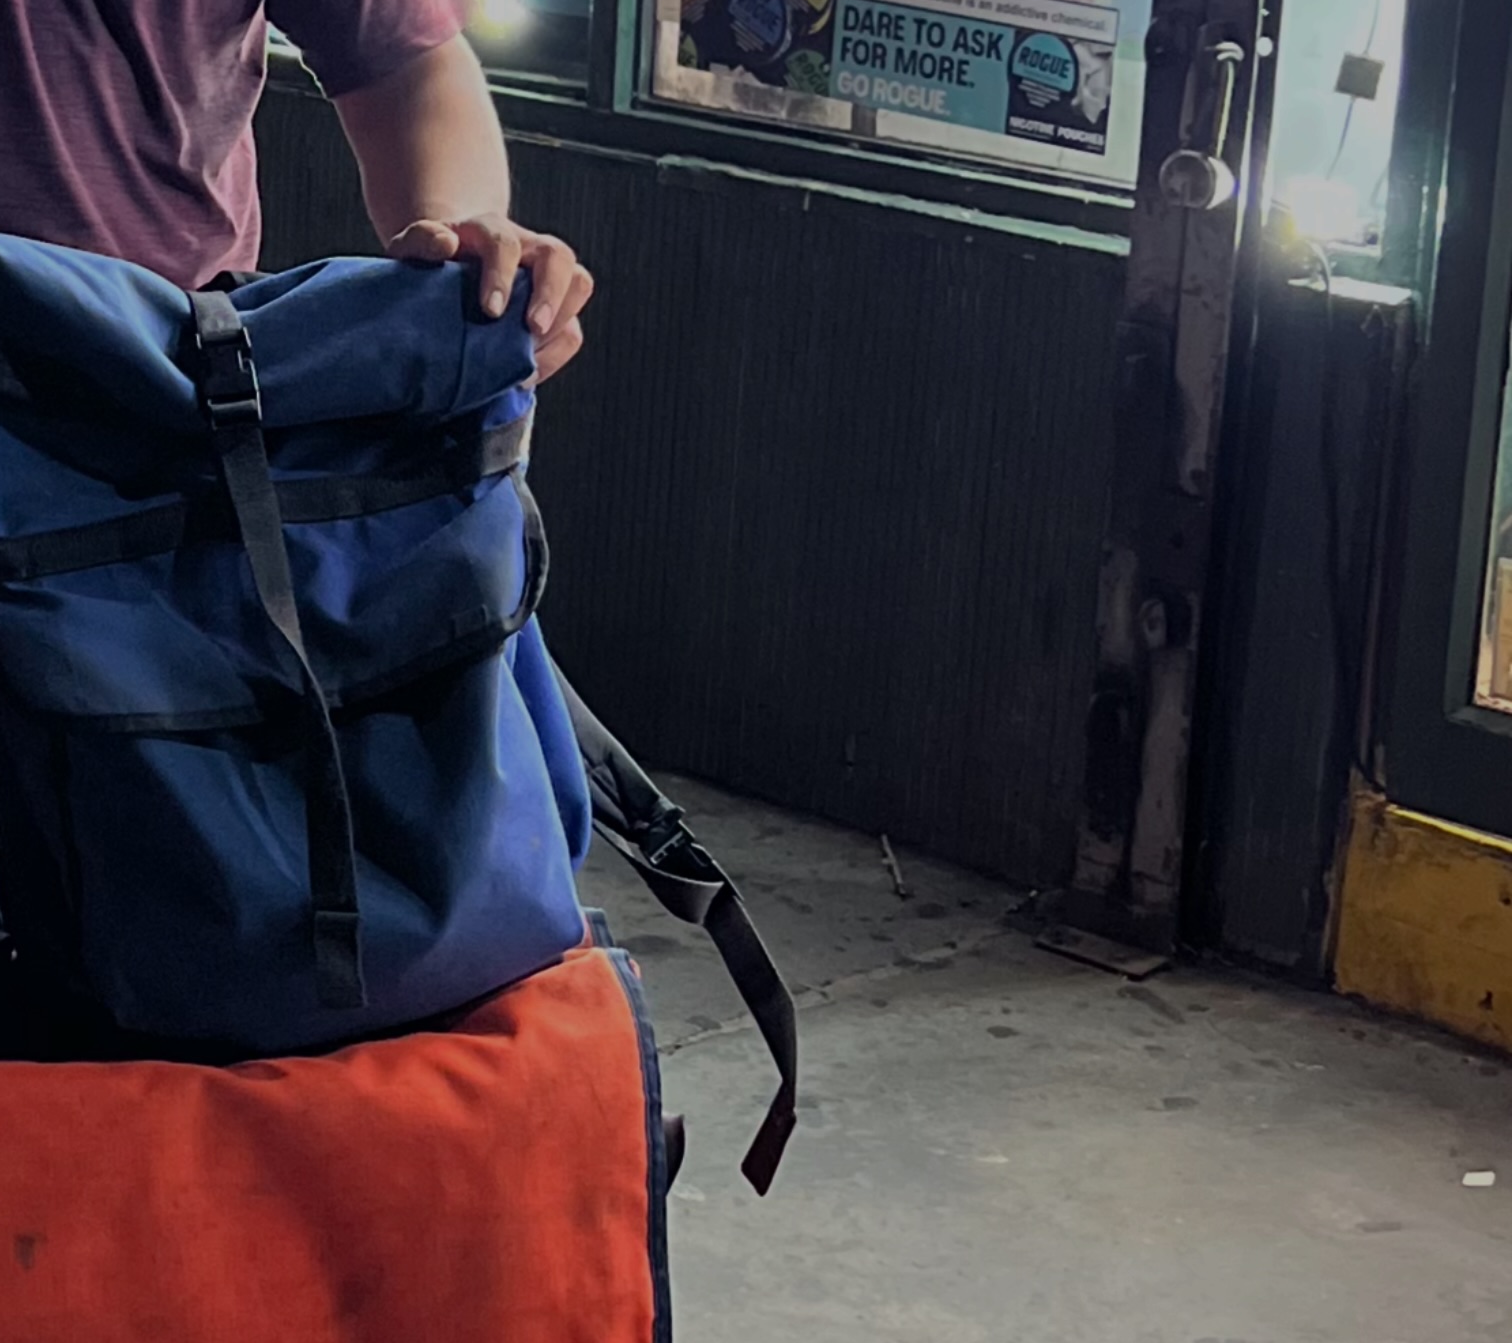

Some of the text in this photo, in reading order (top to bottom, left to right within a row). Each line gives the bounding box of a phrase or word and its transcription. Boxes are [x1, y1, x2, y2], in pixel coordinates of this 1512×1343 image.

[842, 4, 1005, 62] DARE TO ASK
[979, 0, 993, 12] an
[996, 1, 1048, 22] addictive
[840, 37, 976, 89] FOR MORE.
[1017, 46, 1072, 79] ROGUE
[838, 70, 952, 116] GO ROGUE.
